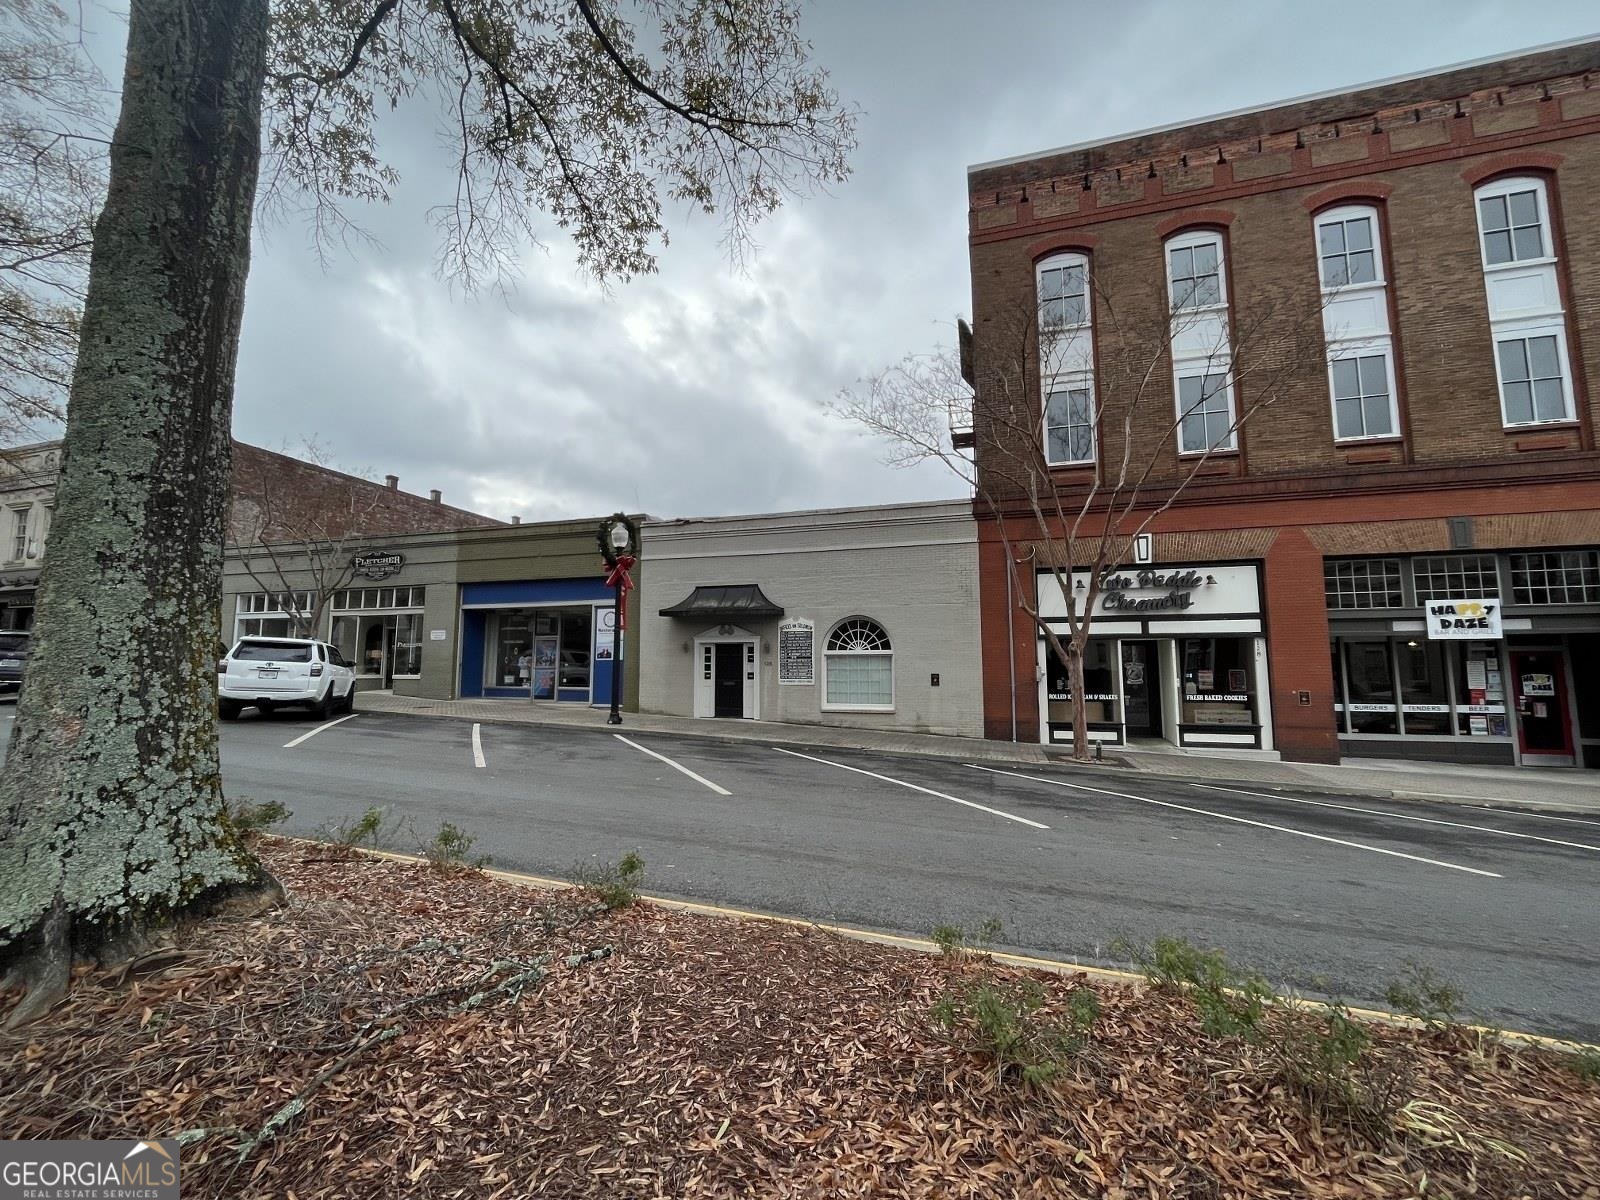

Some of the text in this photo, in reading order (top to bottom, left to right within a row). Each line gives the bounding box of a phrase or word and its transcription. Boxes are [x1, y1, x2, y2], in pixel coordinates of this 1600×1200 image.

[355, 556, 400, 568] FLETCHER
[1137, 569, 1203, 588] Paddle
[1101, 590, 1195, 611] Creamery
[1440, 617, 1489, 629] DAZE
